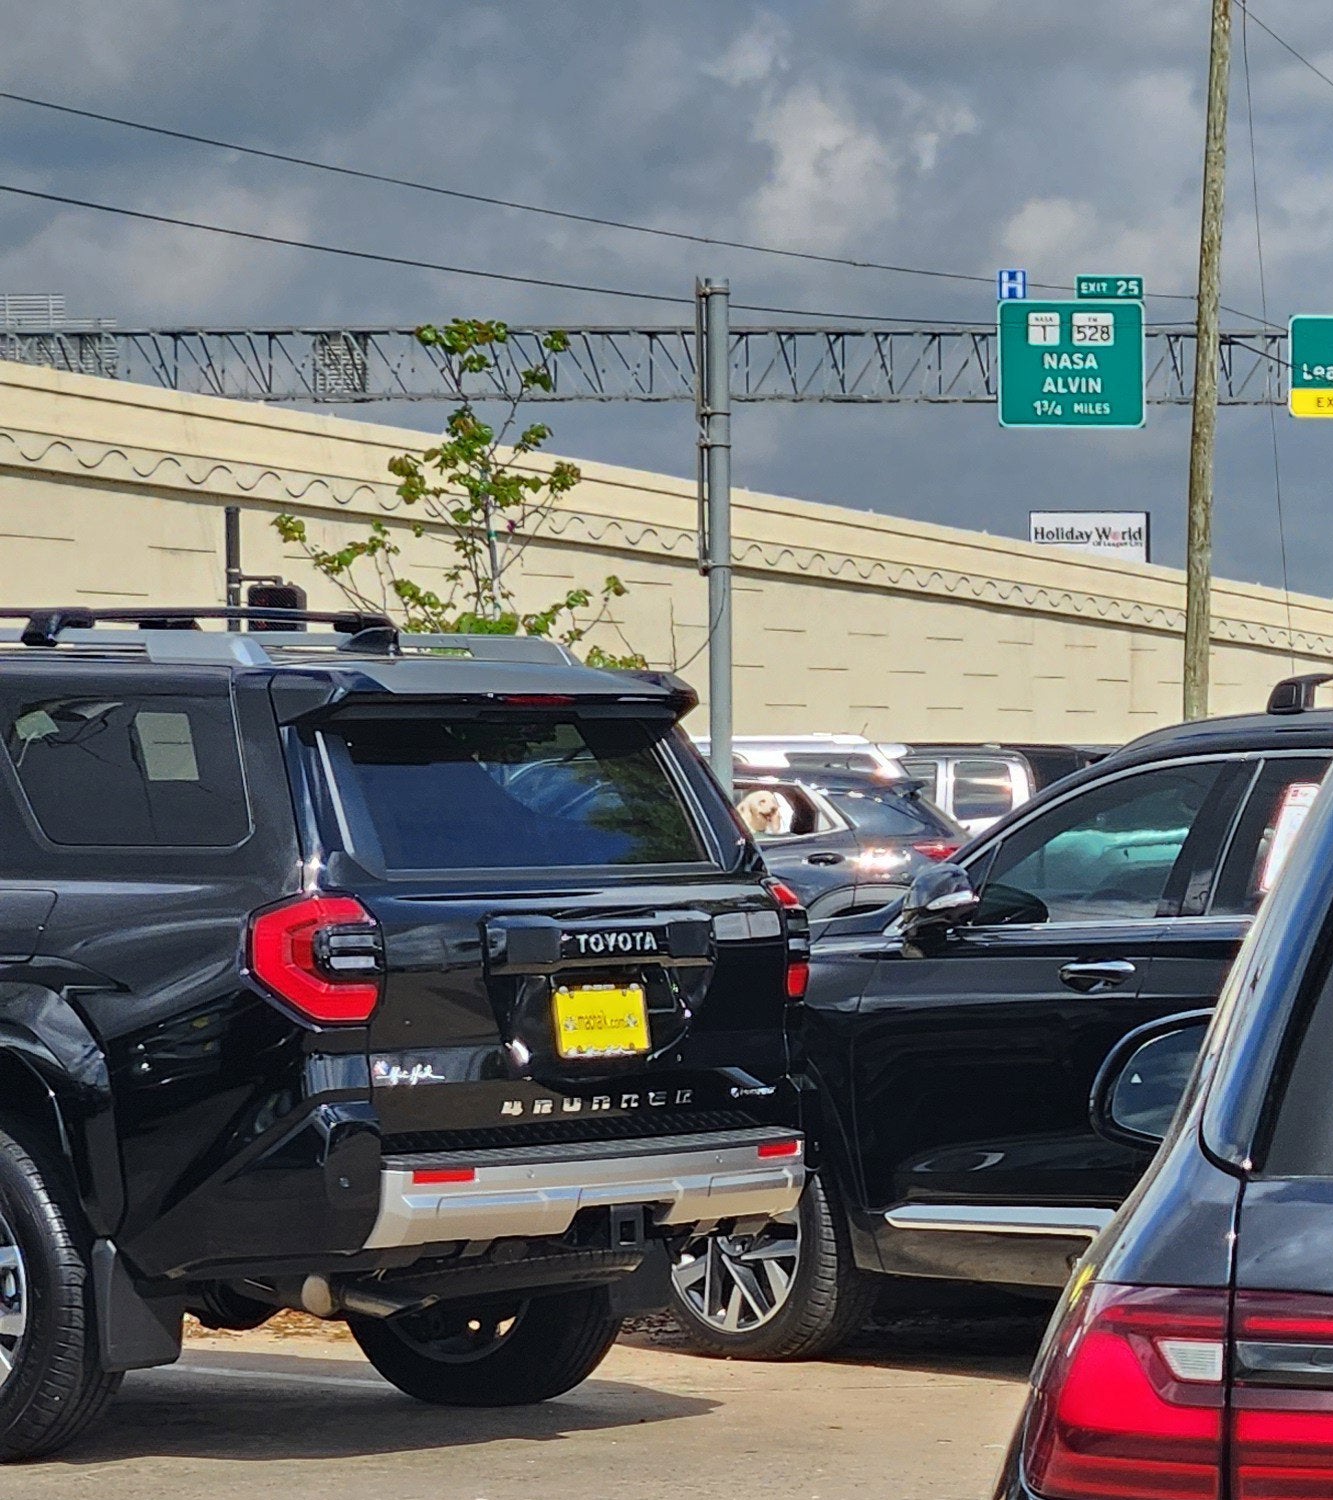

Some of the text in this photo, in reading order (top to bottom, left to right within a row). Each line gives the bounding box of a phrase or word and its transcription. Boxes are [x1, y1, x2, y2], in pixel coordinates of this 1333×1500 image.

[1001, 270, 1024, 298] H
[1080, 280, 1139, 296] EXIT 25
[1040, 325, 1047, 342] 1
[1076, 325, 1110, 341] 528
[1043, 352, 1098, 370] NASA
[1042, 376, 1102, 394] ALVIN
[1073, 402, 1110, 415] MILES
[1034, 527, 1143, 544] Holiday World
[575, 931, 658, 954] TOYOTA
[500, 1089, 693, 1116] 4RUNNER
